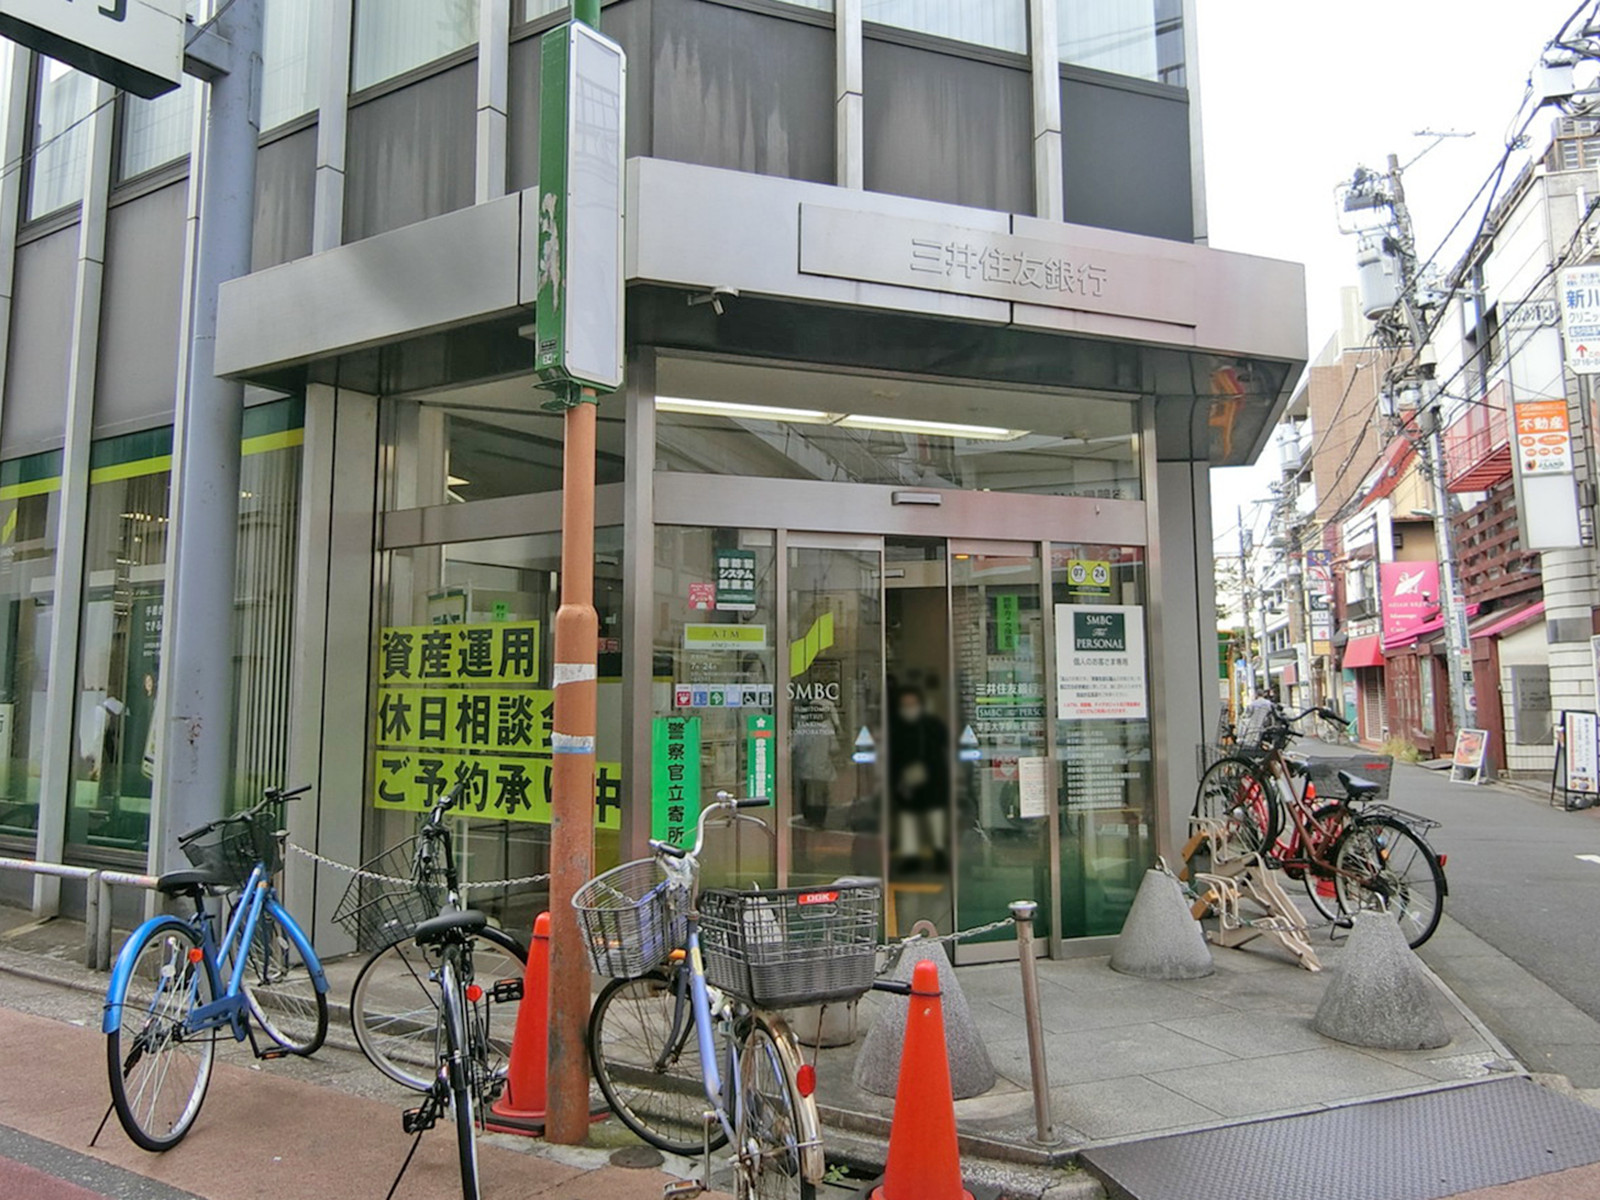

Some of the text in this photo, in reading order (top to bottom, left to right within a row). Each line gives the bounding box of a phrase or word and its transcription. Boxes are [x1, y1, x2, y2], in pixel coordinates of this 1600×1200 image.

[910, 238, 1107, 297] 三井住友銀行
[1519, 416, 1564, 432] 不動産
[719, 569, 754, 579] システム
[1094, 568, 1105, 578] 24
[1086, 615, 1113, 626] SMBC
[1076, 638, 1124, 650] PERSONAL
[382, 627, 535, 680] 資産運用
[786, 682, 840, 701] SMBC
[975, 682, 1039, 696] 三井住友銀行
[979, 708, 1003, 717] SMBC
[667, 722, 686, 844] 警察官立寄所
